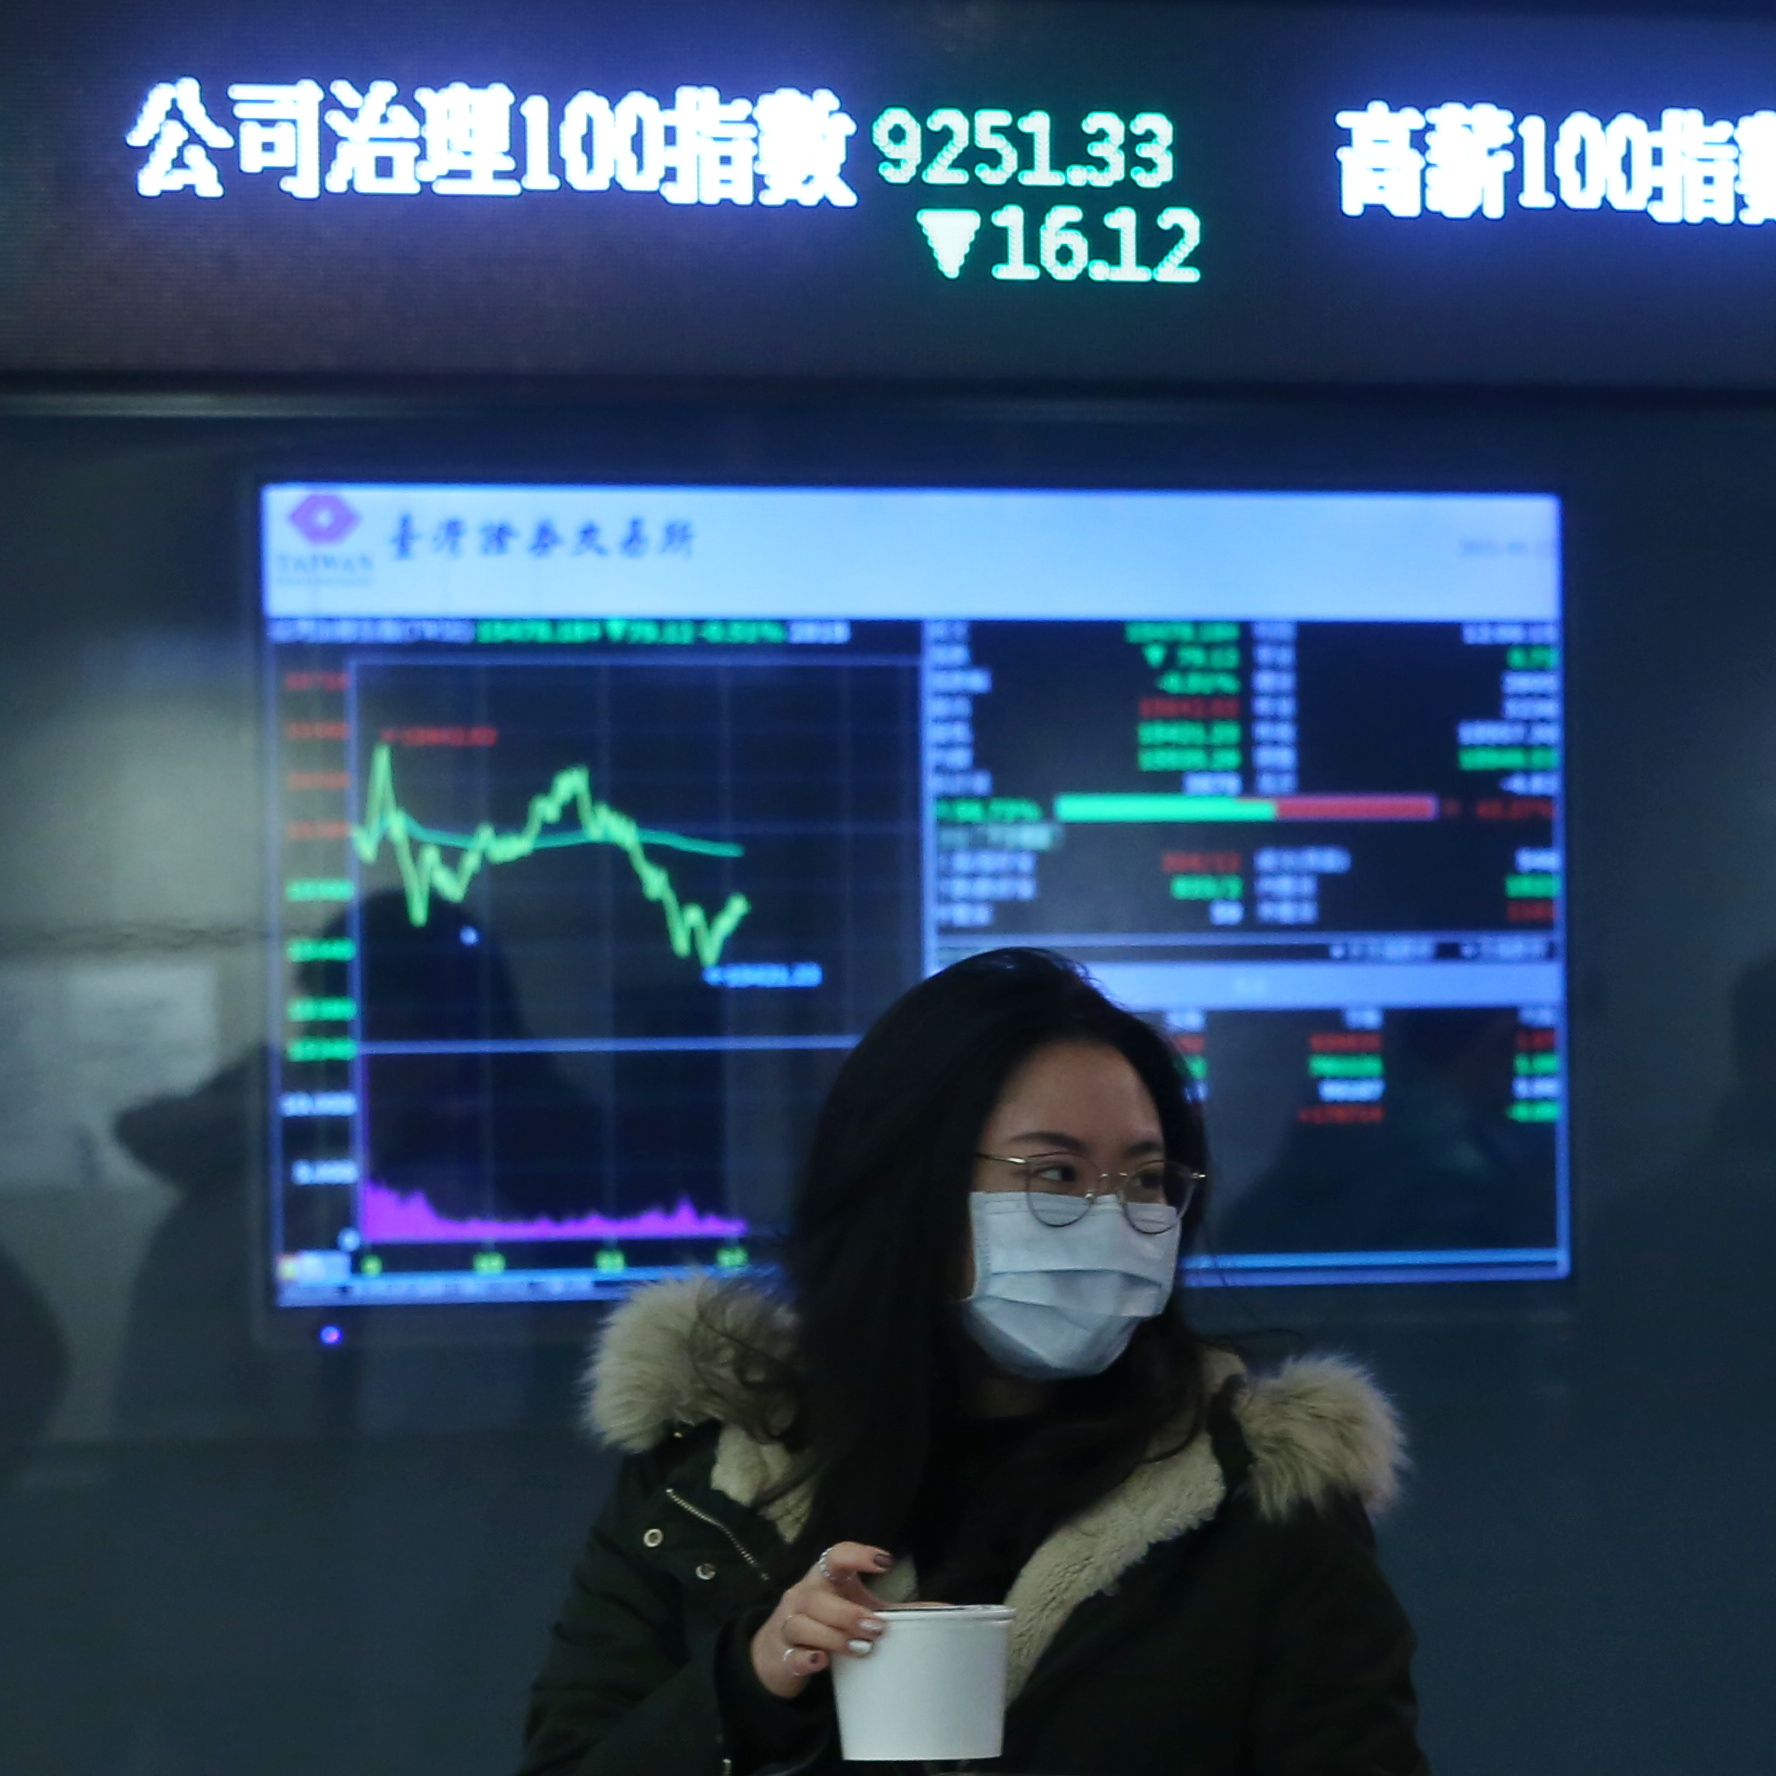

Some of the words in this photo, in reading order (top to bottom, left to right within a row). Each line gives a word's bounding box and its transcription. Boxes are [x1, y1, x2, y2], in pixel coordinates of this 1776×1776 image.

[127, 78, 857, 207] 公司治理100指數
[872, 108, 1174, 189] 9251.33
[992, 204, 1201, 284] 16.12
